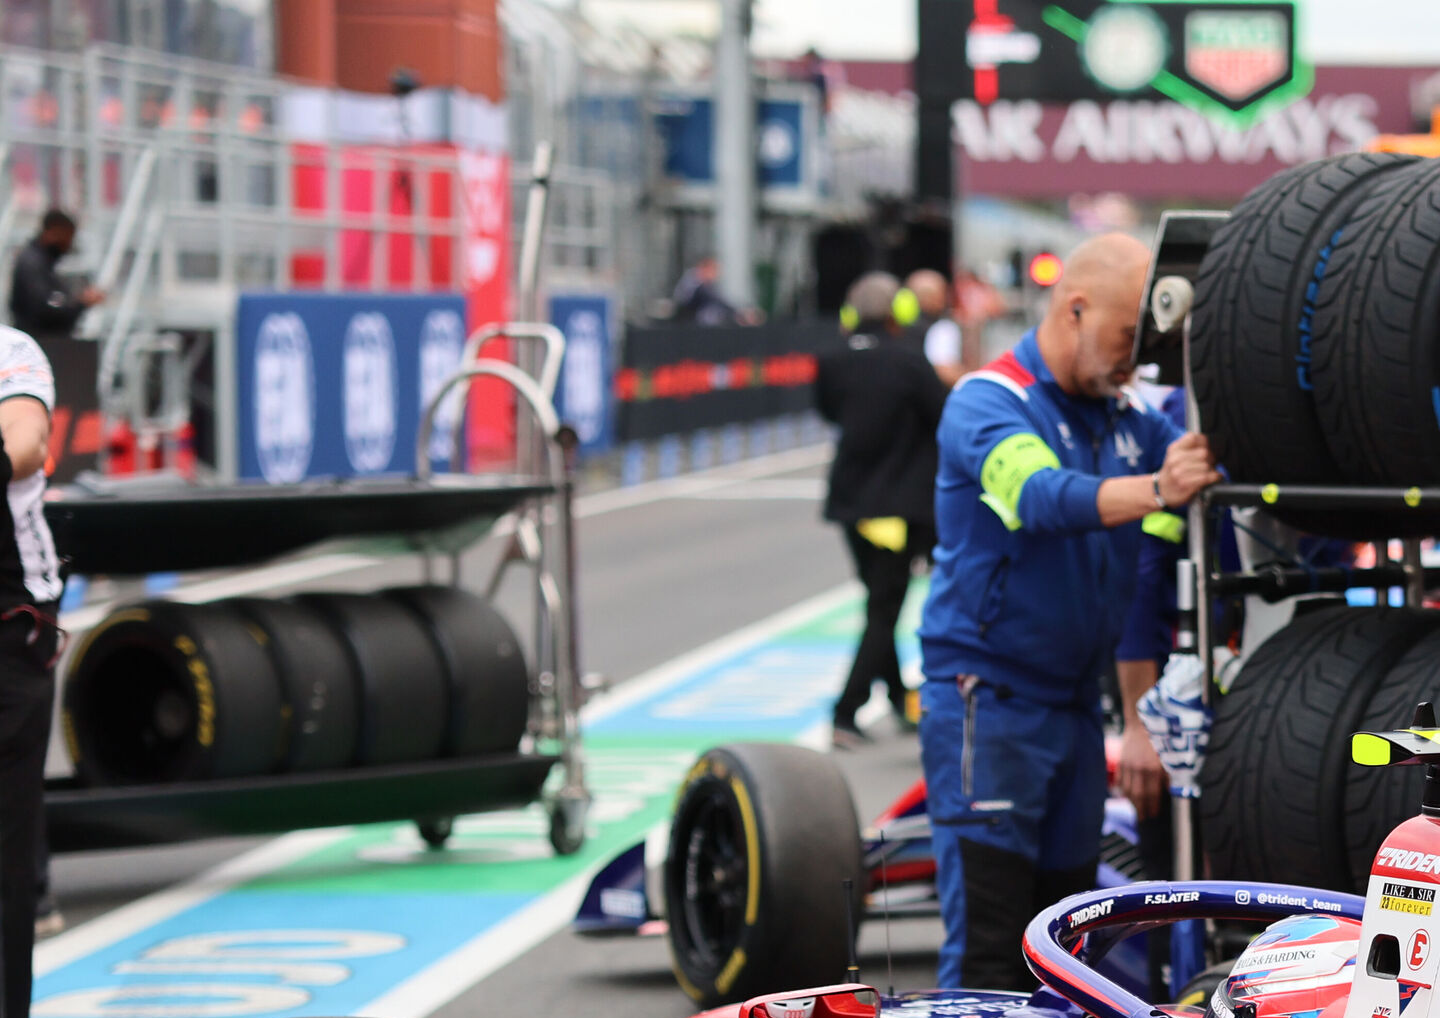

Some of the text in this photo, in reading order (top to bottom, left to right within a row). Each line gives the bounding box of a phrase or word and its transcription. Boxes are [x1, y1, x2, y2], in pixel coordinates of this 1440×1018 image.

[1053, 95, 1380, 163] AIRWAYS
[1144, 892, 1200, 905] F.SLATER
[1384, 882, 1435, 901] LIKE A SIR
[1257, 893, 1342, 912] @trident_team
[1068, 899, 1115, 929] TRIDENT
[1265, 950, 1316, 965] HARDING
[1410, 932, 1427, 966] E
